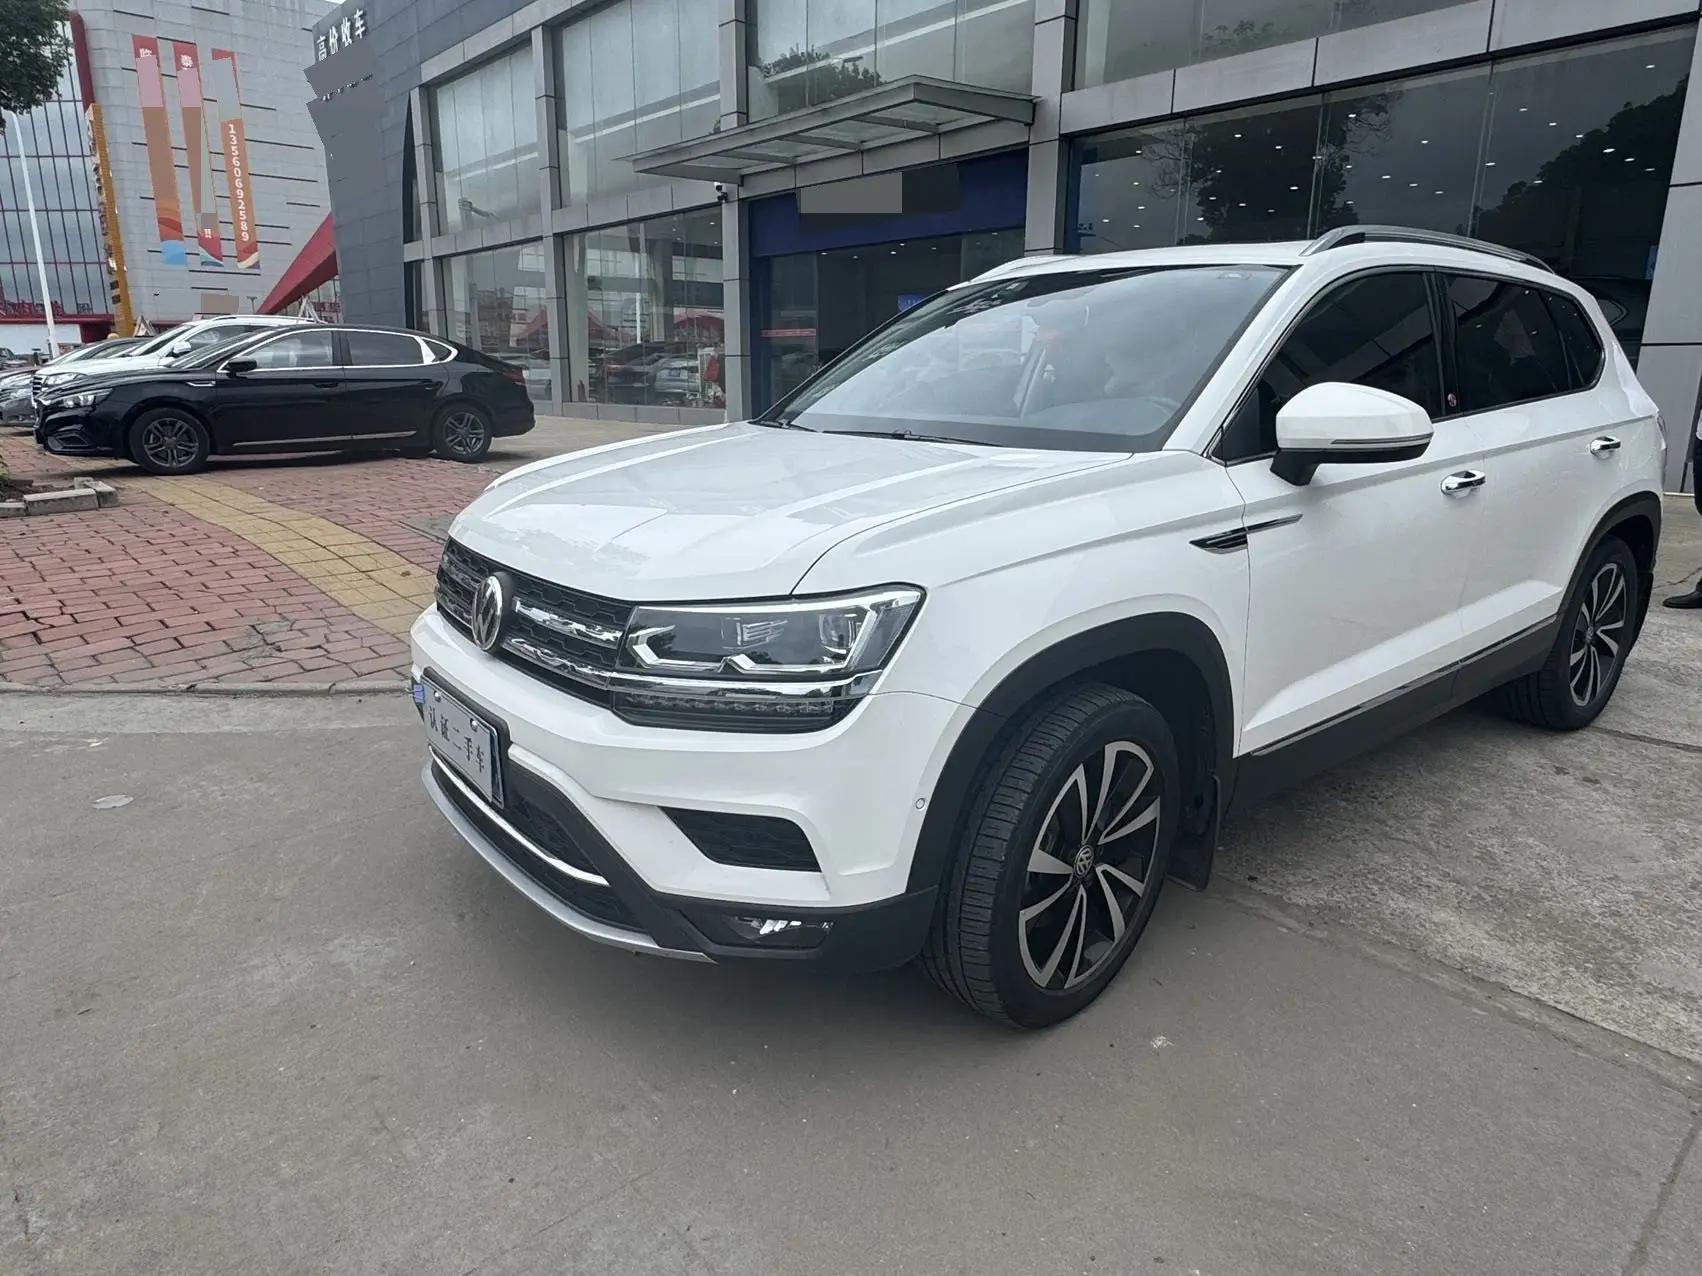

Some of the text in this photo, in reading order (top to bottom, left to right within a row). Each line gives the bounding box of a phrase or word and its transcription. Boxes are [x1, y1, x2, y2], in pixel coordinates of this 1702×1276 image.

[316, 8, 366, 61] 高价收车
[228, 123, 250, 242] 13560692589
[428, 705, 485, 773] 认证二手车
